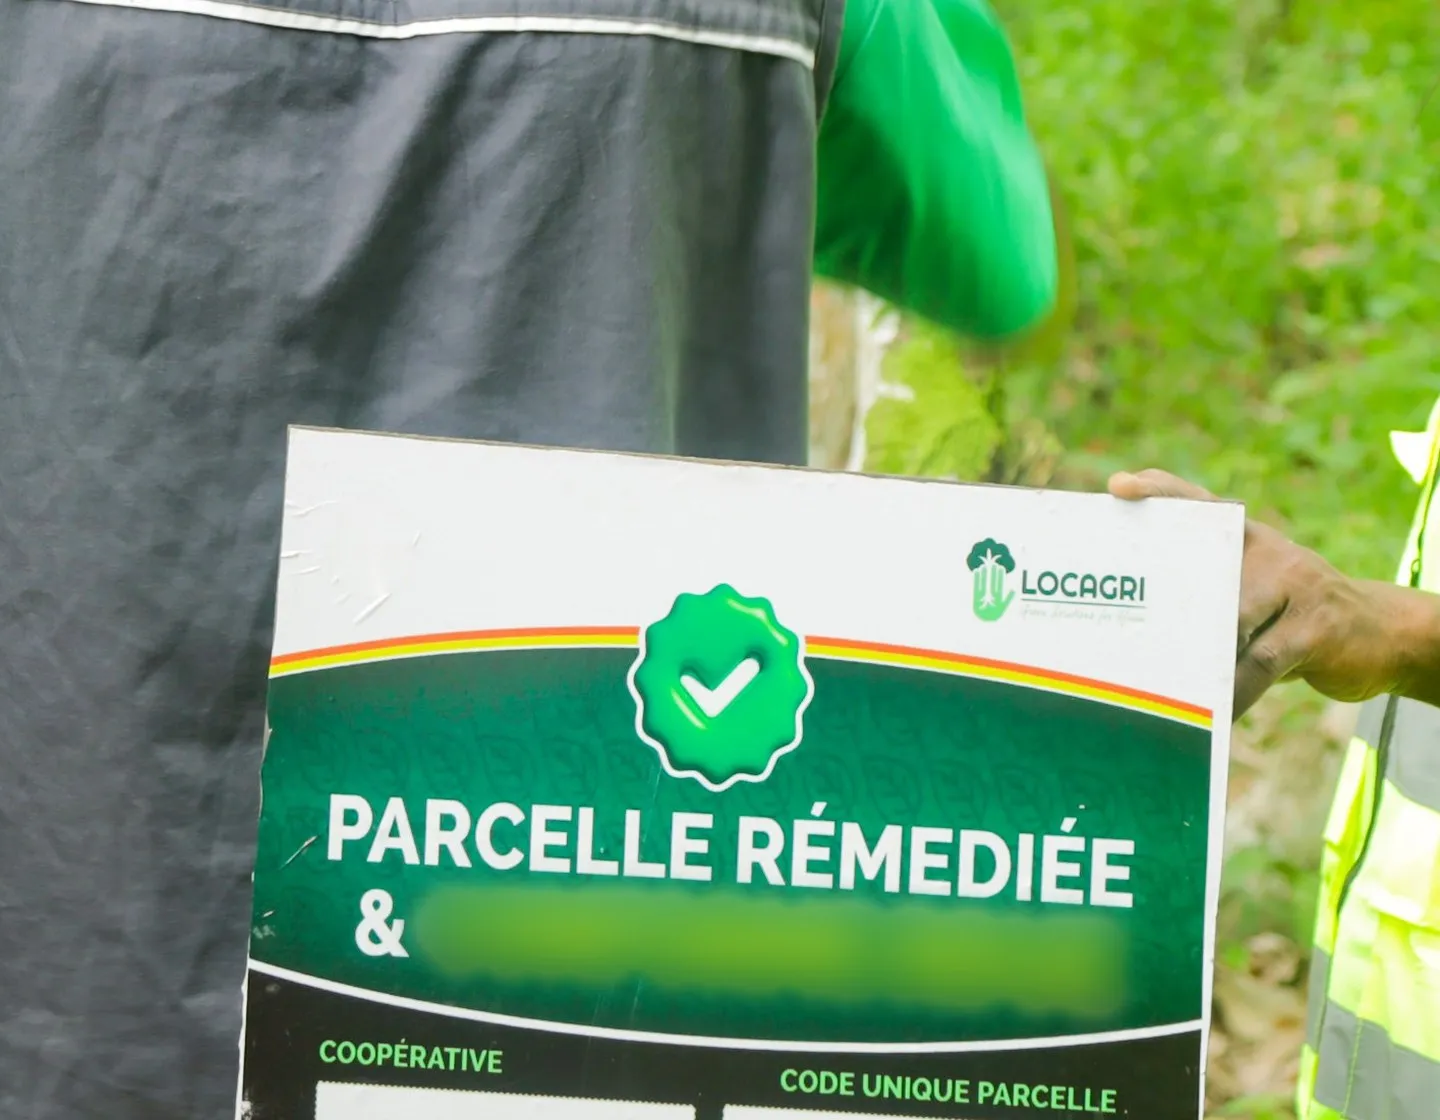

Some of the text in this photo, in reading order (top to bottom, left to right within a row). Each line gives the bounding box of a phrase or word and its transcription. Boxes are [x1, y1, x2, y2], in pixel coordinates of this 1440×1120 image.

[1021, 569, 1146, 602] LOCAGRI
[326, 792, 1136, 908] PARCELLE RÉMEDIÉE
[355, 888, 410, 959] &
[319, 1037, 504, 1075] COOPÉRATIVE
[779, 1068, 1118, 1114] CODE UNIQUE PARCELLE
